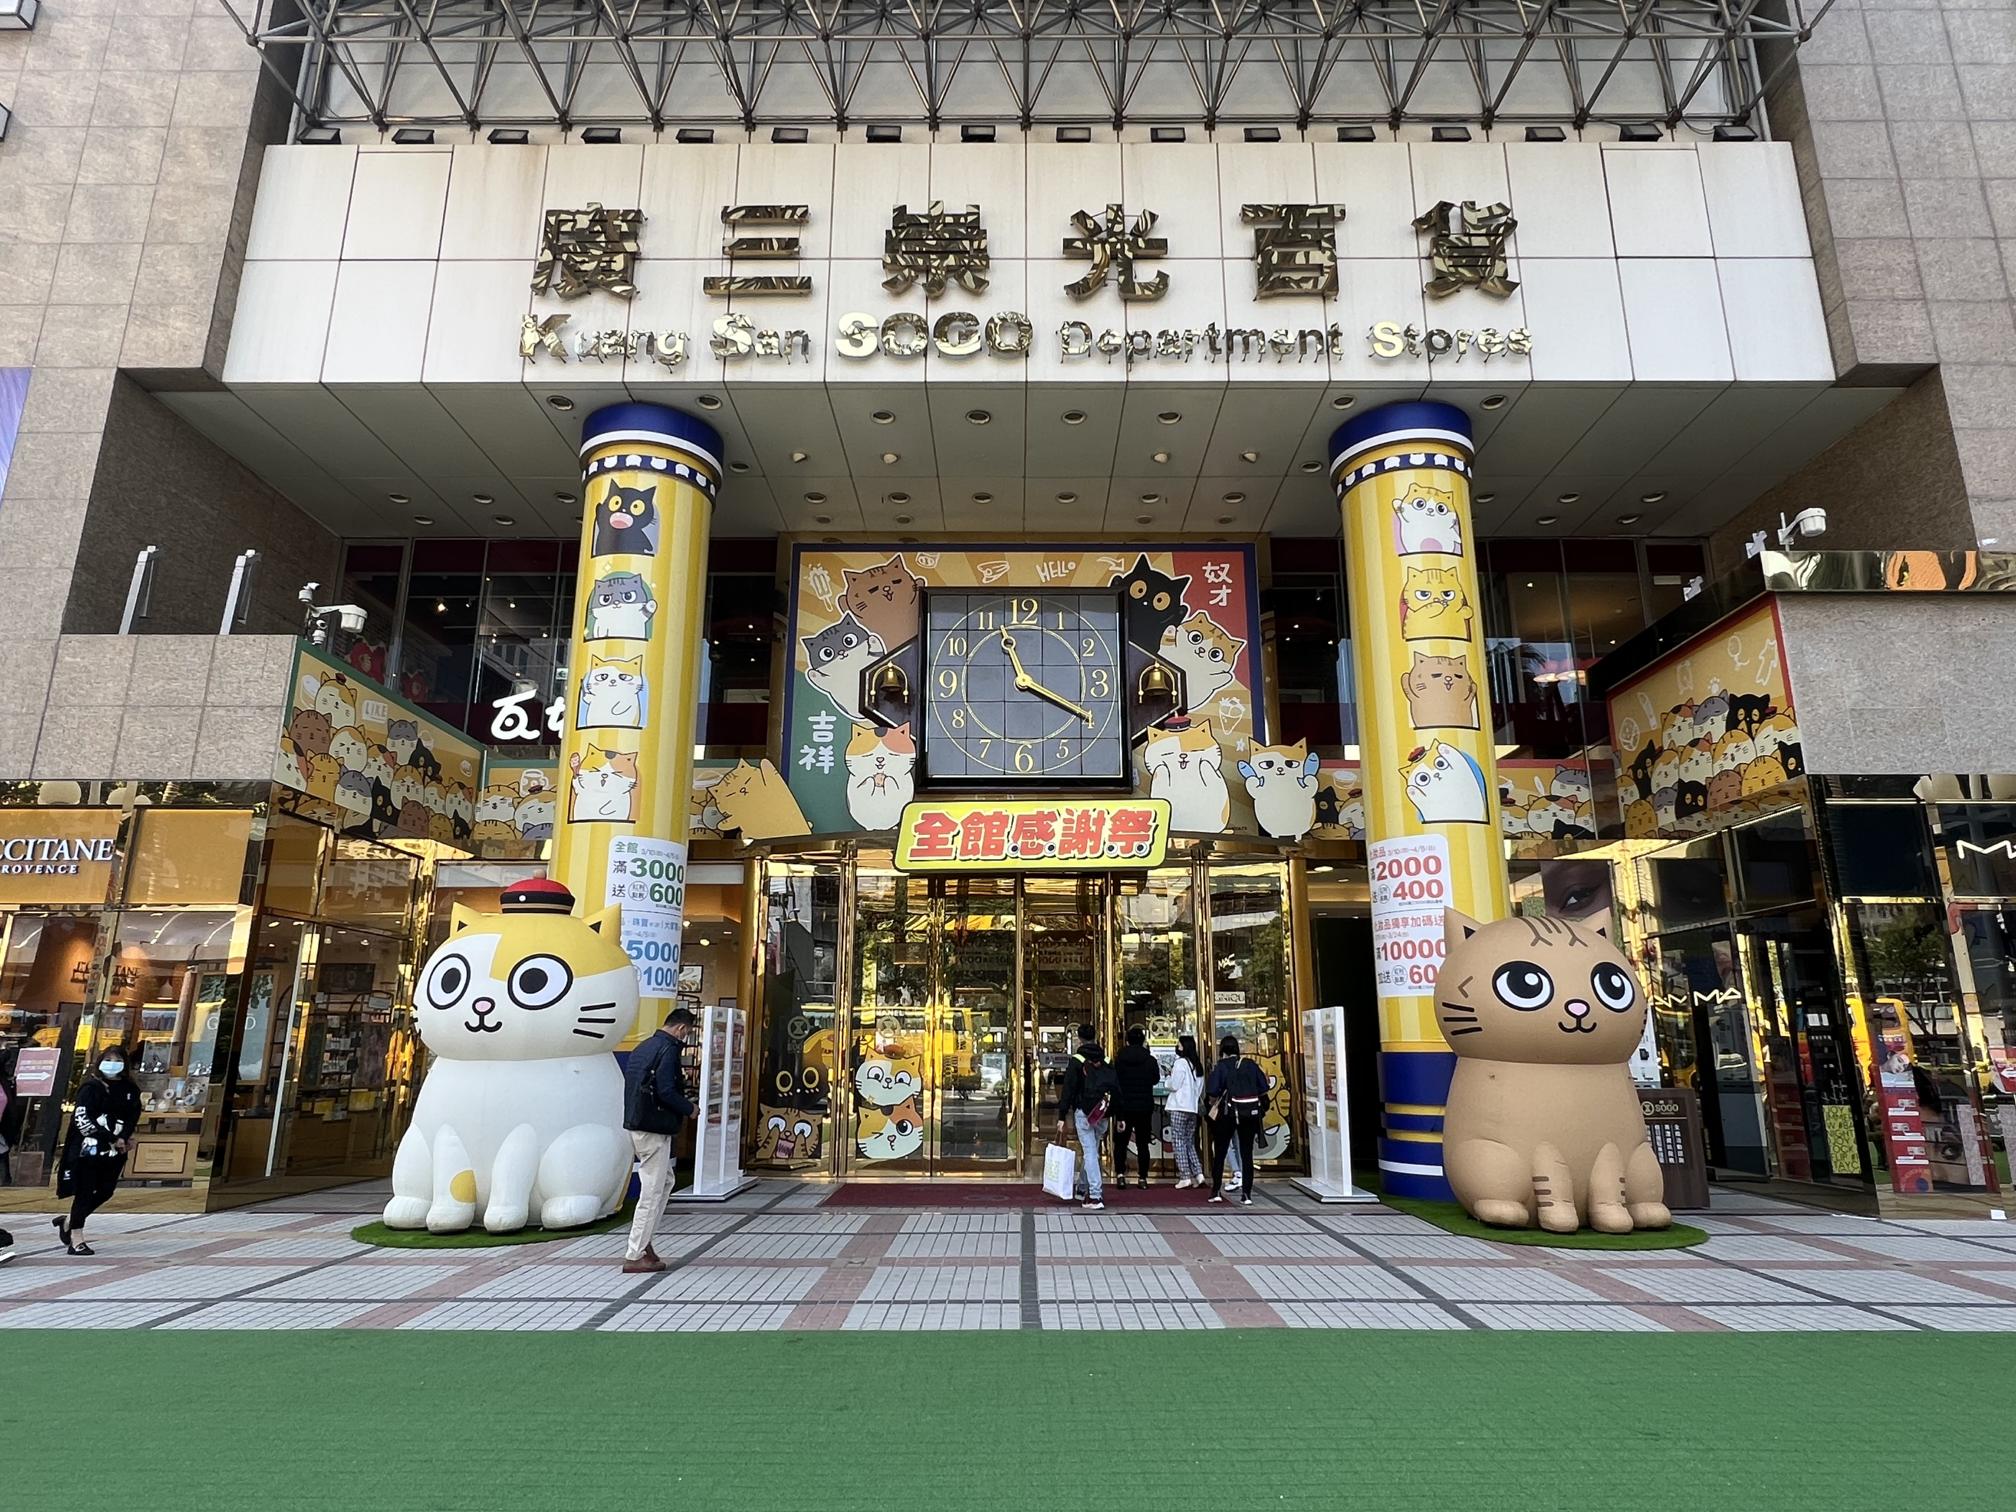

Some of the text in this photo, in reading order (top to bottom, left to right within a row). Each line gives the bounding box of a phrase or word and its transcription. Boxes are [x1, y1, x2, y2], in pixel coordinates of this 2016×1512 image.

[531, 200, 1521, 300] 廣三崇光百貨
[519, 311, 1535, 372] Kuang San SOGO Department Stores
[1035, 561, 1076, 583] HELLO
[1202, 561, 1233, 607] 奴才
[978, 611, 994, 630] 11
[1010, 598, 1038, 625] 12
[1056, 612, 1064, 630] 1
[949, 637, 967, 656] 10
[1082, 638, 1095, 657] 2
[938, 669, 958, 699] 9
[1090, 669, 1109, 698] 3
[951, 708, 965, 729] 8
[1082, 710, 1095, 729] 4
[799, 709, 837, 775] 吉祥
[979, 738, 992, 759] 7
[1056, 738, 1069, 759] 5
[1014, 743, 1034, 773] 6
[909, 807, 1154, 860] 全館感謝祭
[0, 838, 113, 861] CITANE
[615, 841, 638, 855] 全館
[629, 857, 685, 884] 3000
[1376, 855, 1442, 882] 2000
[649, 882, 683, 907] 600
[1392, 878, 1444, 901] 400
[626, 939, 680, 964] 5000
[1381, 938, 1446, 961] 10000
[643, 966, 678, 988] 1000
